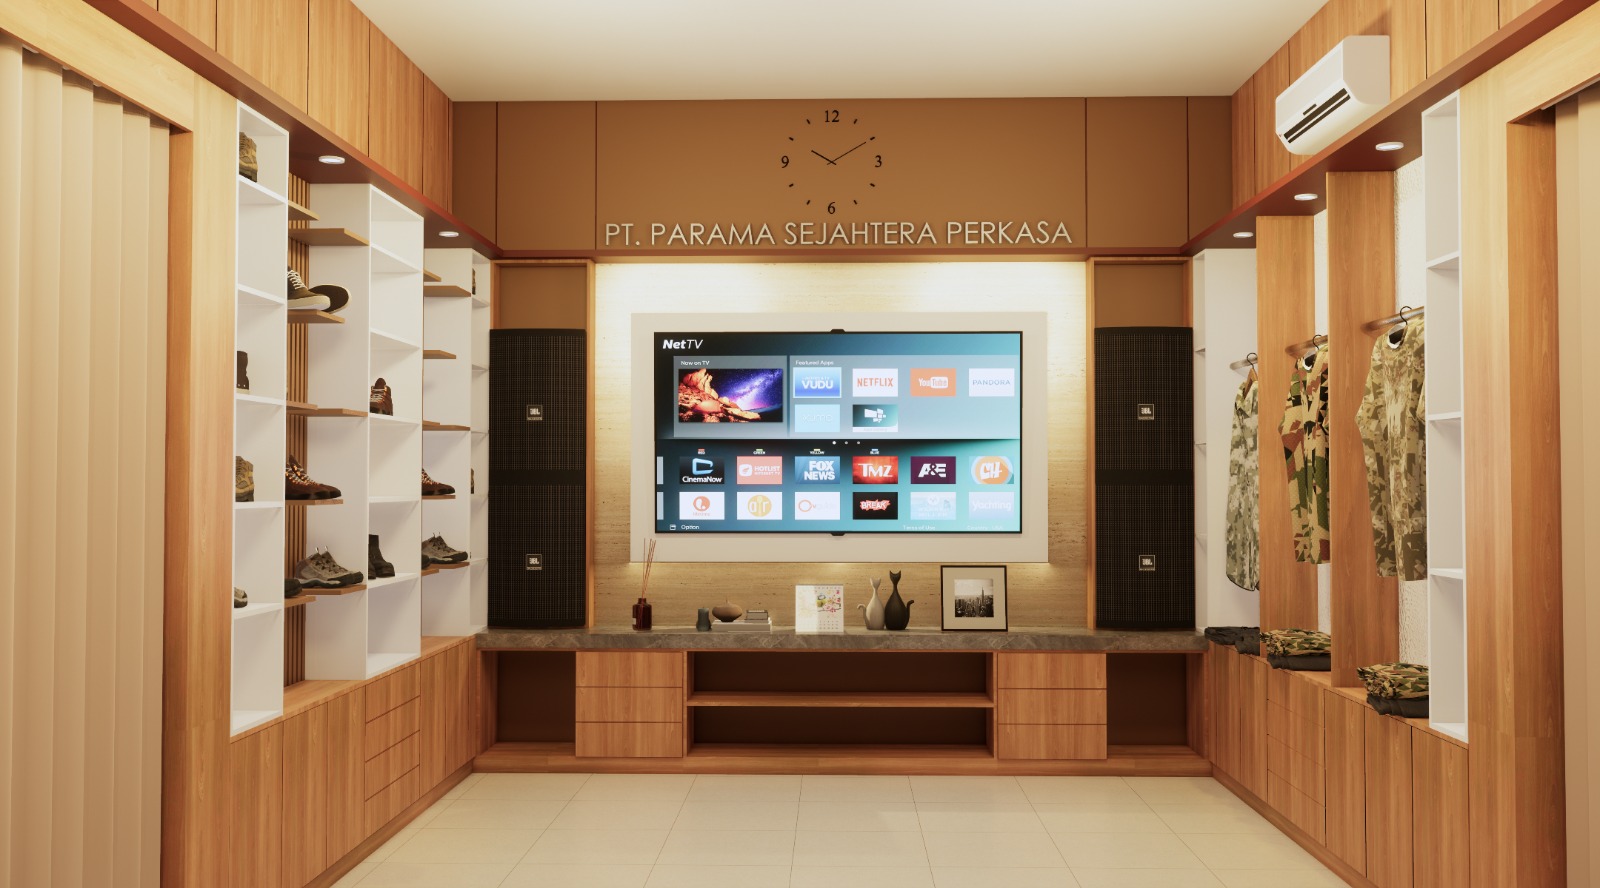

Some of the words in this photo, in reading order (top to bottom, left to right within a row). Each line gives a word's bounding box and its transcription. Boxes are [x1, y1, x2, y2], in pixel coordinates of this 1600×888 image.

[824, 110, 840, 123] 12
[781, 155, 790, 169] 9
[874, 155, 882, 168] 3
[827, 202, 836, 215] 6
[605, 223, 640, 246] PT.
[651, 222, 776, 246] PARAMA
[783, 221, 938, 246] SEJAHTERA
[947, 220, 1073, 245] PERKASA
[662, 339, 703, 350] NetTV
[802, 380, 834, 390] VUDU
[857, 377, 894, 388] NETFLIX
[918, 376, 949, 389] YouTube
[809, 460, 835, 472] FOX
[858, 463, 893, 478] TMZ
[918, 463, 947, 478] A&E
[803, 471, 836, 481] NEWS
[861, 500, 889, 510] BREAK
